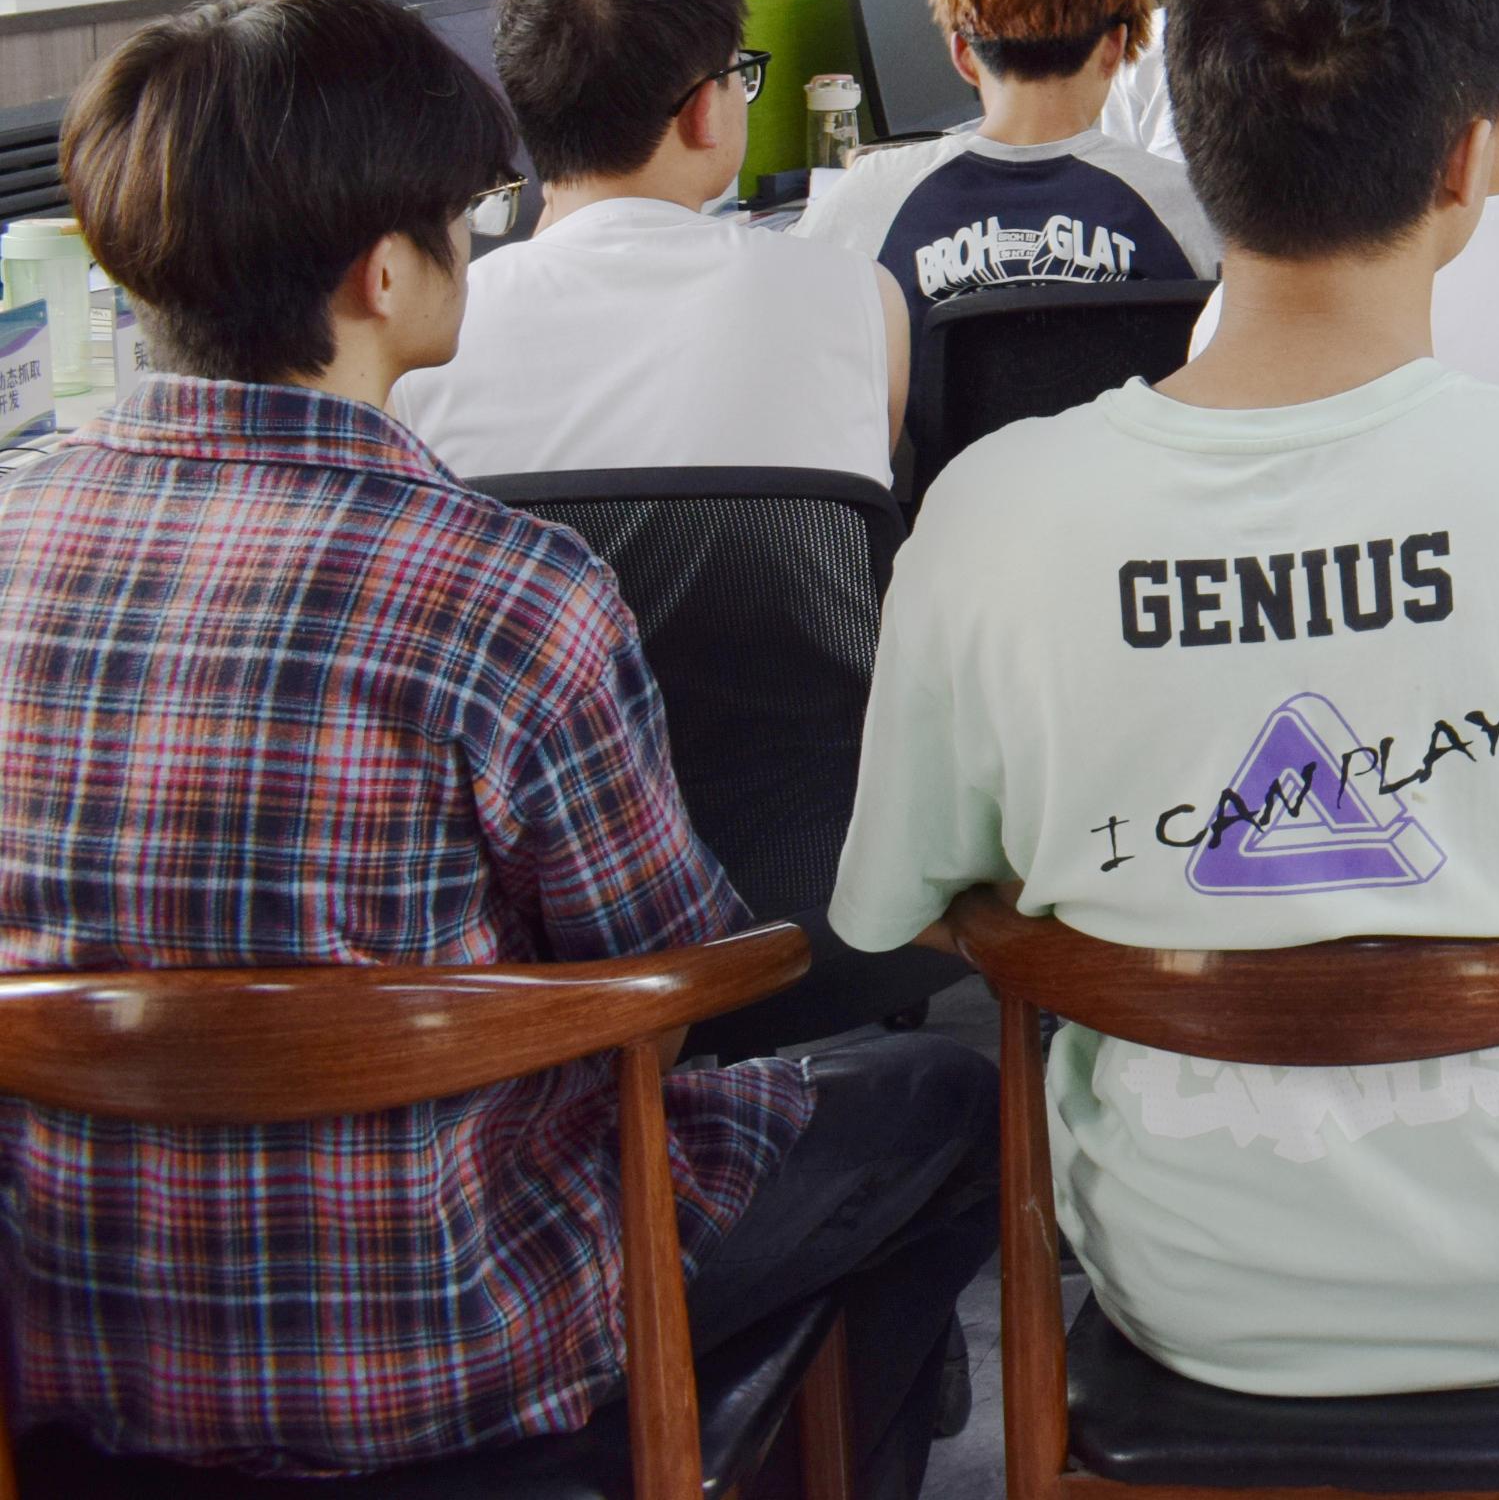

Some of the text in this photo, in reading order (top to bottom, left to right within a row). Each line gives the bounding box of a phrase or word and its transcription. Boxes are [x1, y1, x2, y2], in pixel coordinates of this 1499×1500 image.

[1050, 215, 1136, 274] GLAT
[1119, 531, 1453, 649] GENIUS
[1091, 815, 1135, 872] I
[1156, 761, 1317, 850] CAN
